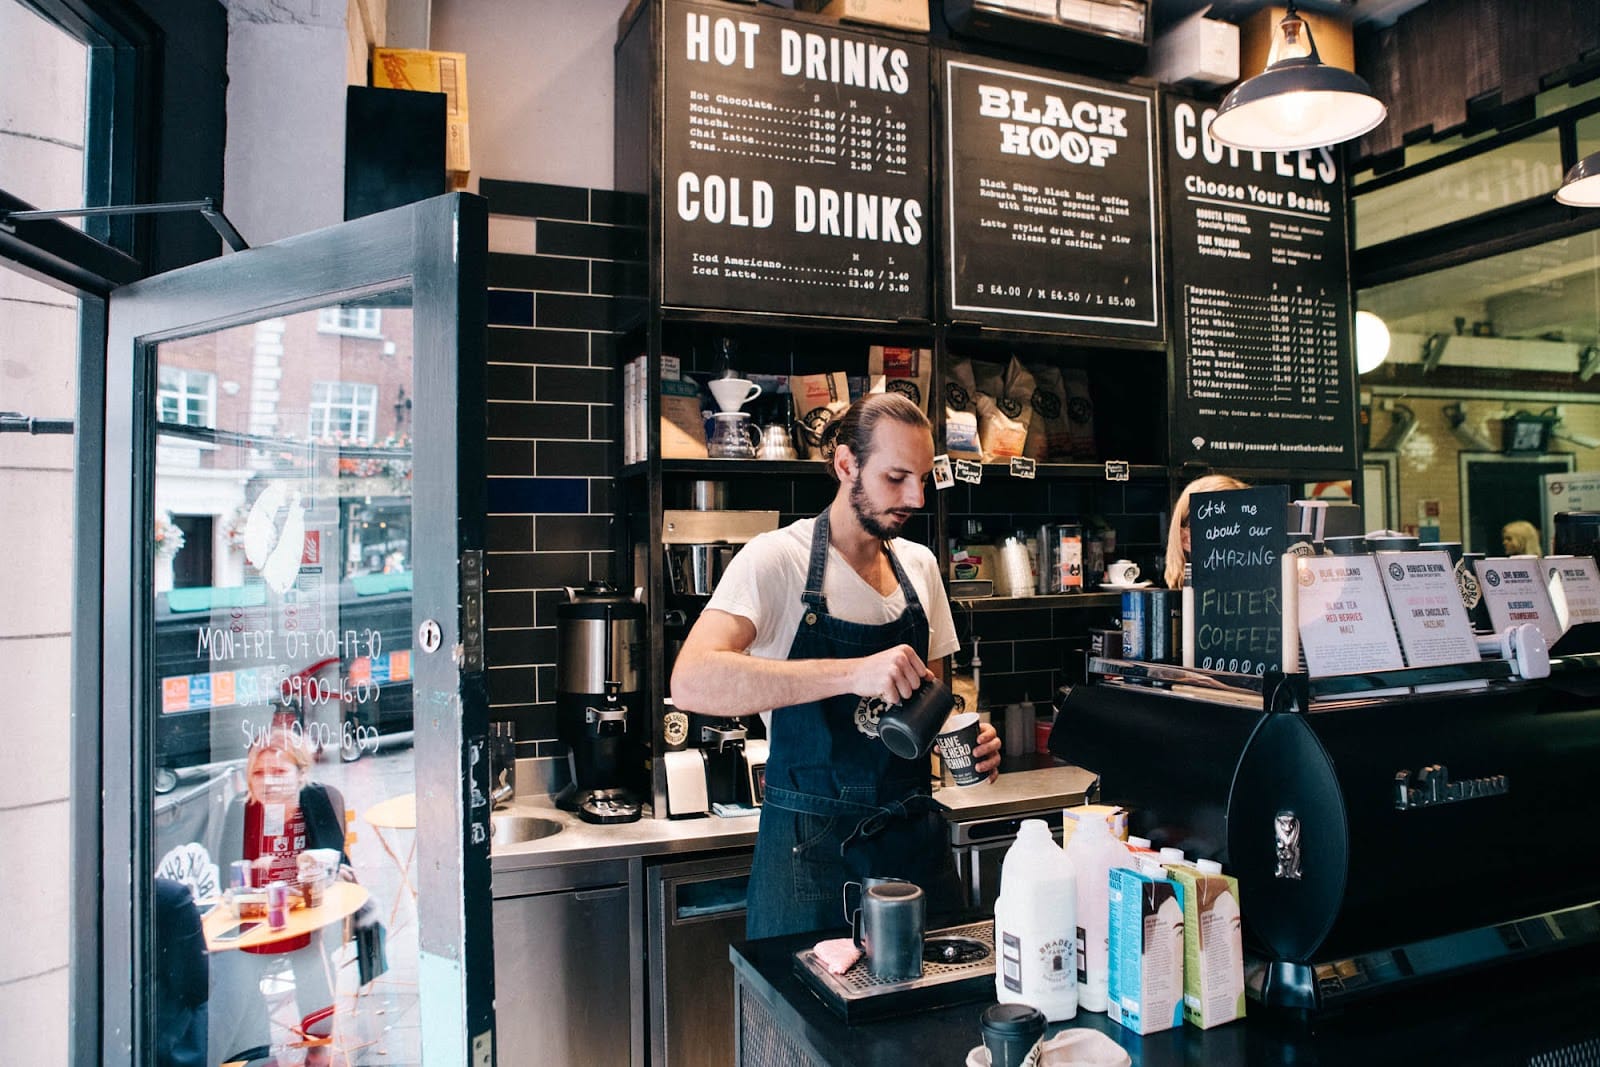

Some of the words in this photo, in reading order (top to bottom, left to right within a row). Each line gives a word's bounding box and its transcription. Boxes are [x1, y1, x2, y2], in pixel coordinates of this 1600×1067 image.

[686, 13, 760, 69] HOT
[781, 28, 909, 94] DRINKS
[690, 91, 709, 101] Hot
[716, 94, 773, 110] Chocolate
[690, 103, 722, 115] Mocha
[885, 105, 892, 114] L
[978, 84, 1128, 137] BLACK
[690, 115, 729, 128] Matcha
[690, 128, 716, 139] Chai
[722, 132, 755, 144] Latte
[1174, 103, 1336, 184] COEES
[690, 140, 716, 151] Teas
[1000, 123, 1117, 167] HOOF
[980, 178, 1007, 189] Black
[1013, 182, 1038, 195] Sheep
[1045, 187, 1070, 198] Black
[1101, 195, 1129, 206] coffee
[1185, 175, 1245, 200] Choose
[1247, 185, 1283, 206] Your
[1287, 191, 1331, 213] Beans
[677, 171, 774, 228] COLD
[795, 185, 922, 246] DRINKS
[980, 188, 1016, 200] Robusta
[1022, 193, 1057, 206] Revival
[1062, 199, 1100, 211] espresso
[1105, 205, 1129, 216] mixed
[998, 201, 1020, 211] with
[1024, 203, 1058, 216] organic
[1062, 209, 1095, 220] coconut
[1099, 215, 1113, 223] oil
[981, 218, 1007, 229] Latte
[1013, 221, 1043, 234] styled
[1050, 226, 1074, 237] drink
[1080, 230, 1094, 240] for
[1111, 234, 1131, 244] slow
[1012, 233, 1046, 243] release
[1051, 236, 1061, 245] of
[1065, 238, 1103, 250] caffeine
[692, 253, 718, 263] Iced
[724, 255, 782, 269] Americano
[848, 267, 874, 278] £3.00
[888, 271, 909, 281] 3.40
[852, 253, 860, 261] M
[888, 257, 895, 265] L
[692, 265, 718, 276] Iced
[724, 267, 757, 280] Latte
[977, 284, 984, 293] S
[990, 284, 1021, 296] £4.00
[1038, 289, 1046, 299] M
[1051, 290, 1080, 302] £4.50
[1096, 295, 1103, 304] L
[1108, 296, 1136, 307] £5.00
[1190, 286, 1226, 296] Espresso
[1190, 296, 1230, 307] Americano
[1191, 307, 1222, 317] Piccolo
[1191, 317, 1209, 326] Flat
[1212, 319, 1235, 328] White
[1191, 327, 1235, 338] Cappuccino
[1191, 337, 1214, 346] Latte
[1192, 347, 1215, 357] Black
[1218, 350, 1236, 359] Hoof
[1192, 358, 1211, 367] Love
[1214, 360, 1244, 370] Berries
[1192, 369, 1211, 377] Blue
[1214, 370, 1245, 379] Volcano
[1210, 441, 1227, 449] FREE
[1228, 442, 1244, 450] WiFi
[1198, 500, 1226, 520] Ask
[1241, 504, 1258, 515] me
[1206, 522, 1241, 540] about
[1249, 525, 1272, 537] our
[1203, 545, 1277, 571] AMAZING
[1406, 565, 1427, 573] ROBUSTA
[1202, 587, 1282, 617] FILTER
[1346, 601, 1357, 610] TEA
[1325, 614, 1338, 623] RED
[1338, 612, 1363, 622] BERRIES
[1411, 609, 1424, 618] DARK
[1424, 607, 1450, 617] CHOCOLATE
[1339, 625, 1354, 634] MALT
[197, 627, 276, 660] MON-FRI
[1198, 623, 1281, 654] COFFEE
[239, 676, 275, 706] SAT
[241, 720, 271, 749] SUN
[936, 736, 961, 748] LEAVE
